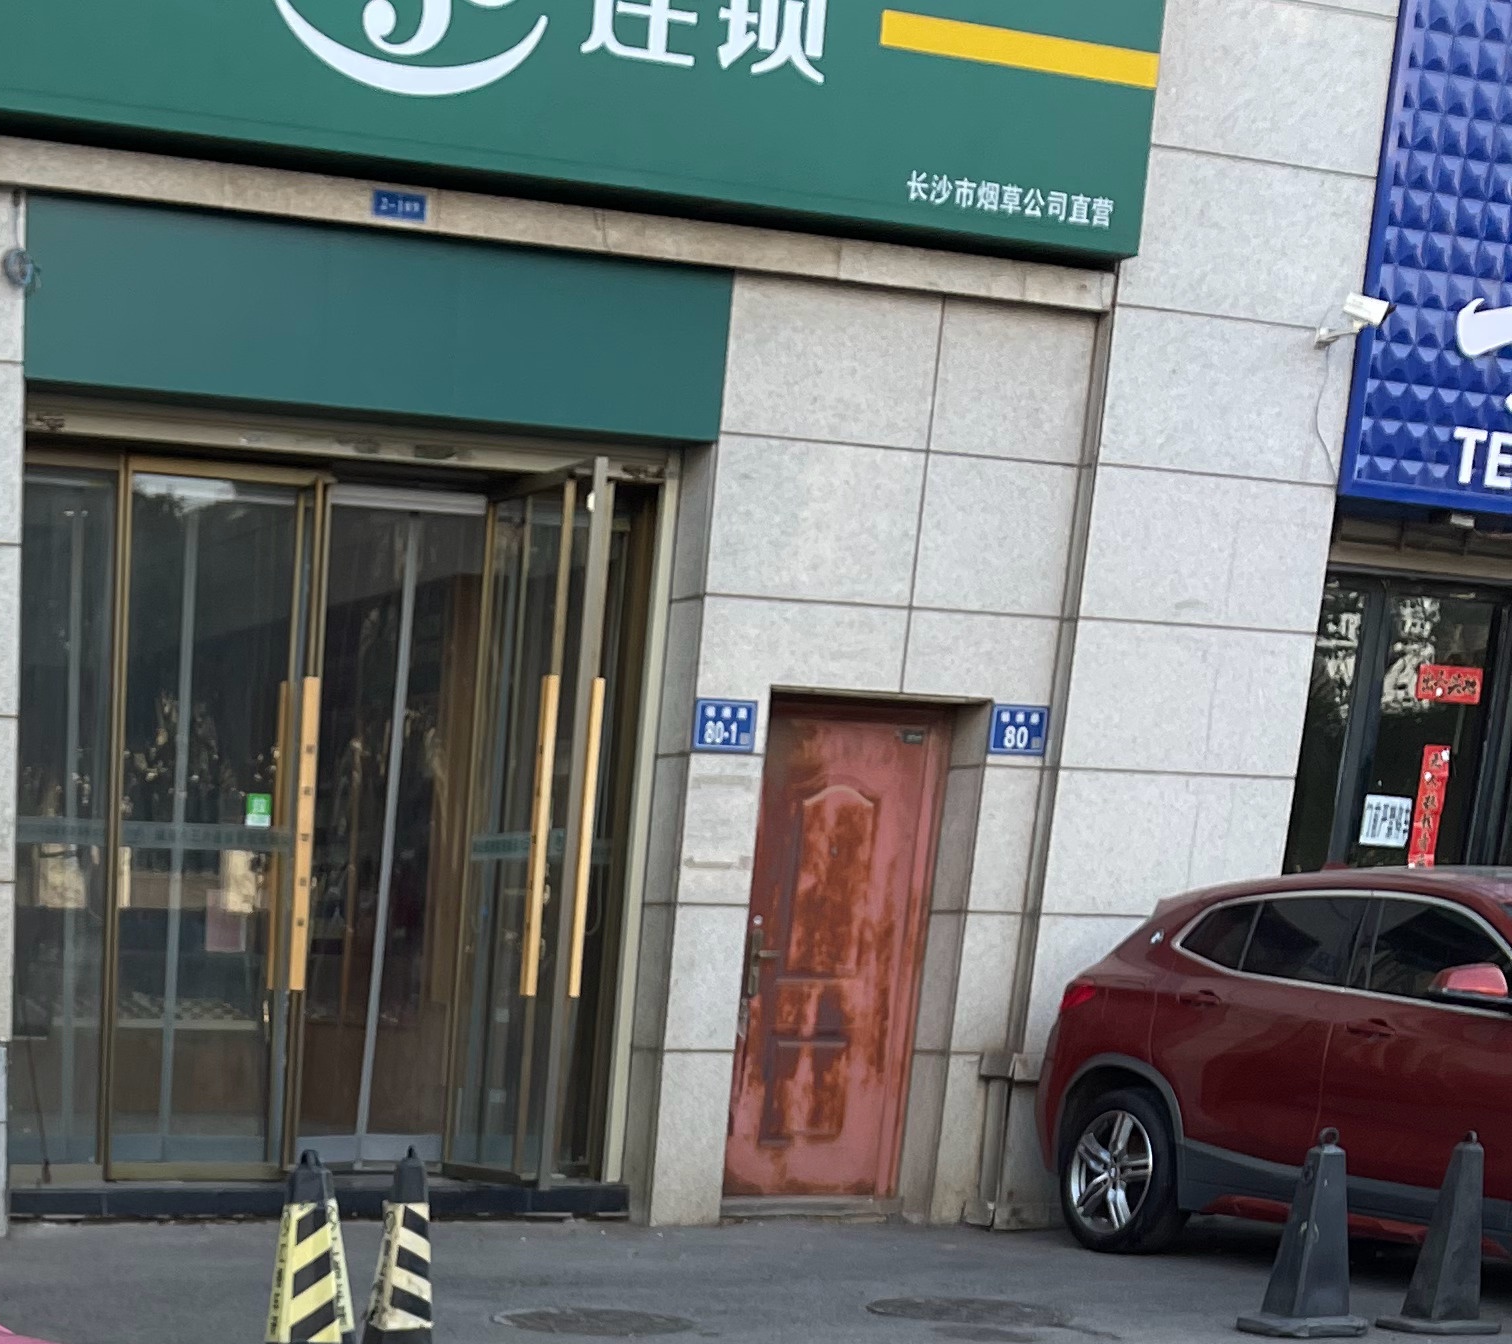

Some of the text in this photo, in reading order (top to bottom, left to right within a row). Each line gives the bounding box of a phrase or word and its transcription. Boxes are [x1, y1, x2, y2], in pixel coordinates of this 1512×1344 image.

[906, 169, 1115, 230] 长沙市烟草公司直营
[1003, 725, 1029, 749] 80
